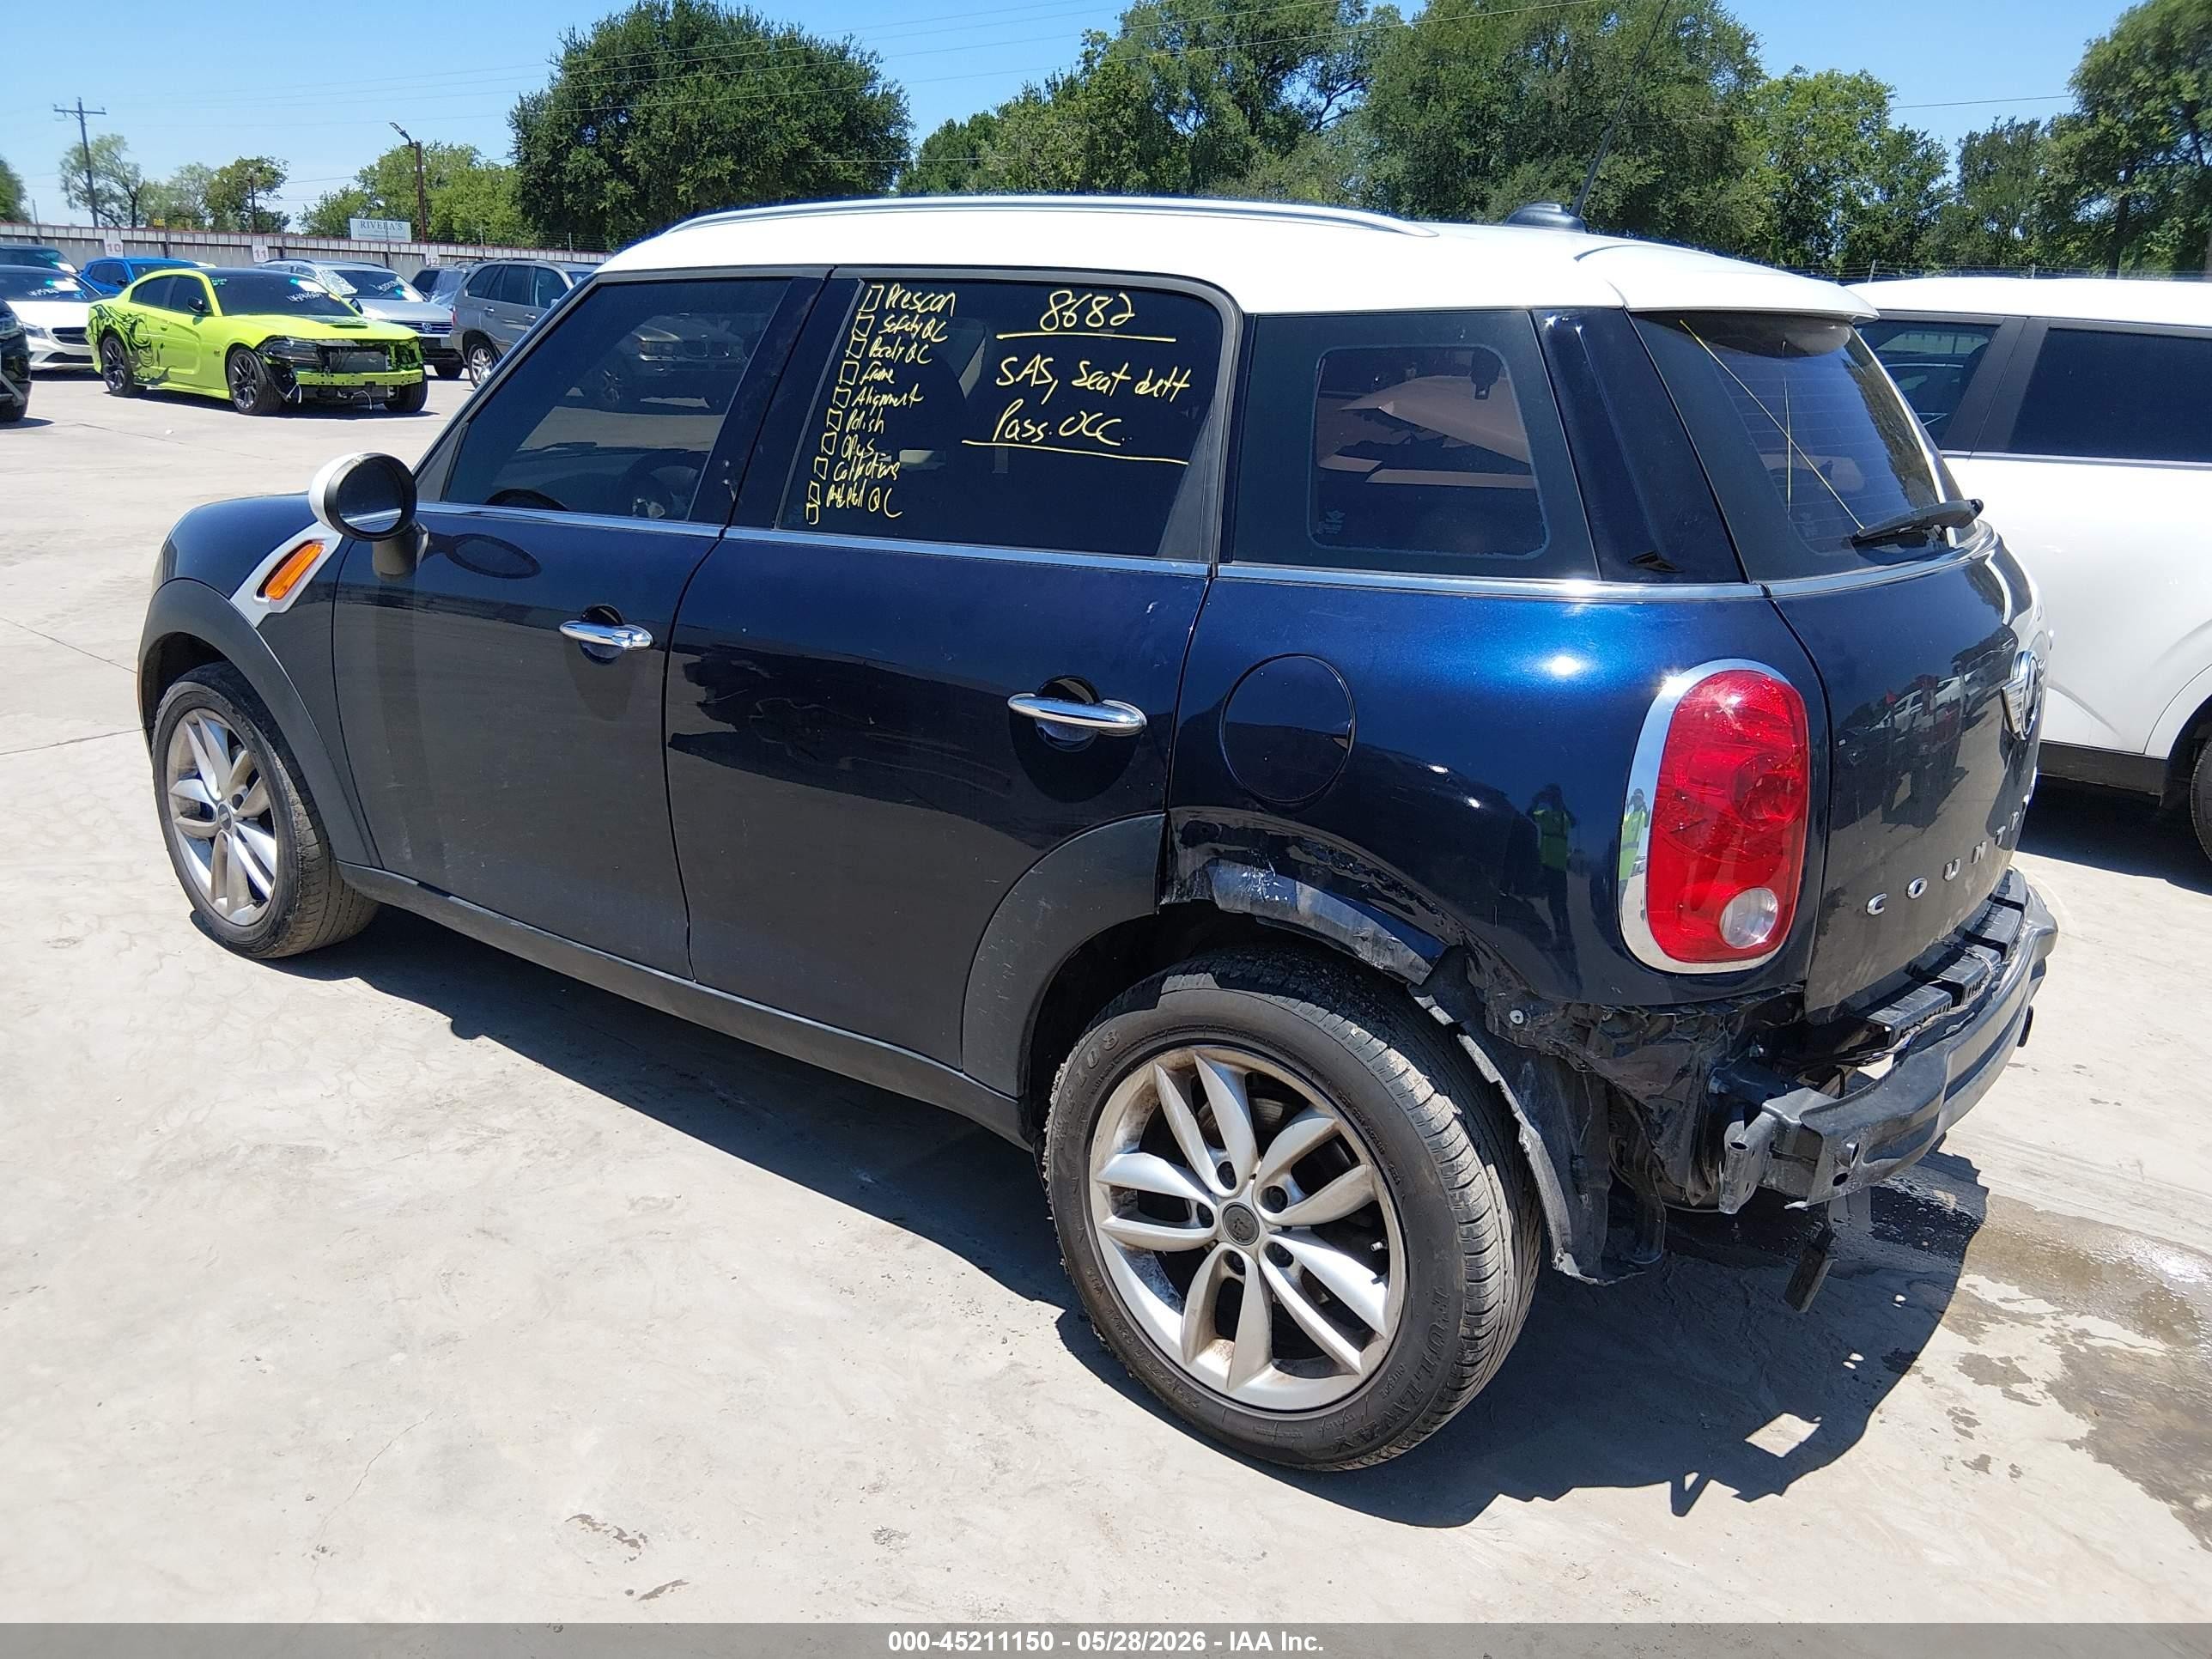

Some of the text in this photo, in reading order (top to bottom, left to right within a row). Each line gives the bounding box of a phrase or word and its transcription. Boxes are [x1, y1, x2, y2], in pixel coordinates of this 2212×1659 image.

[106, 243, 122, 252] 10
[253, 248, 267, 258] 11
[1039, 289, 1136, 331] 8682
[921, 317, 949, 343] QC
[904, 341, 933, 365] QC
[1865, 793, 2030, 916] COUNTR
